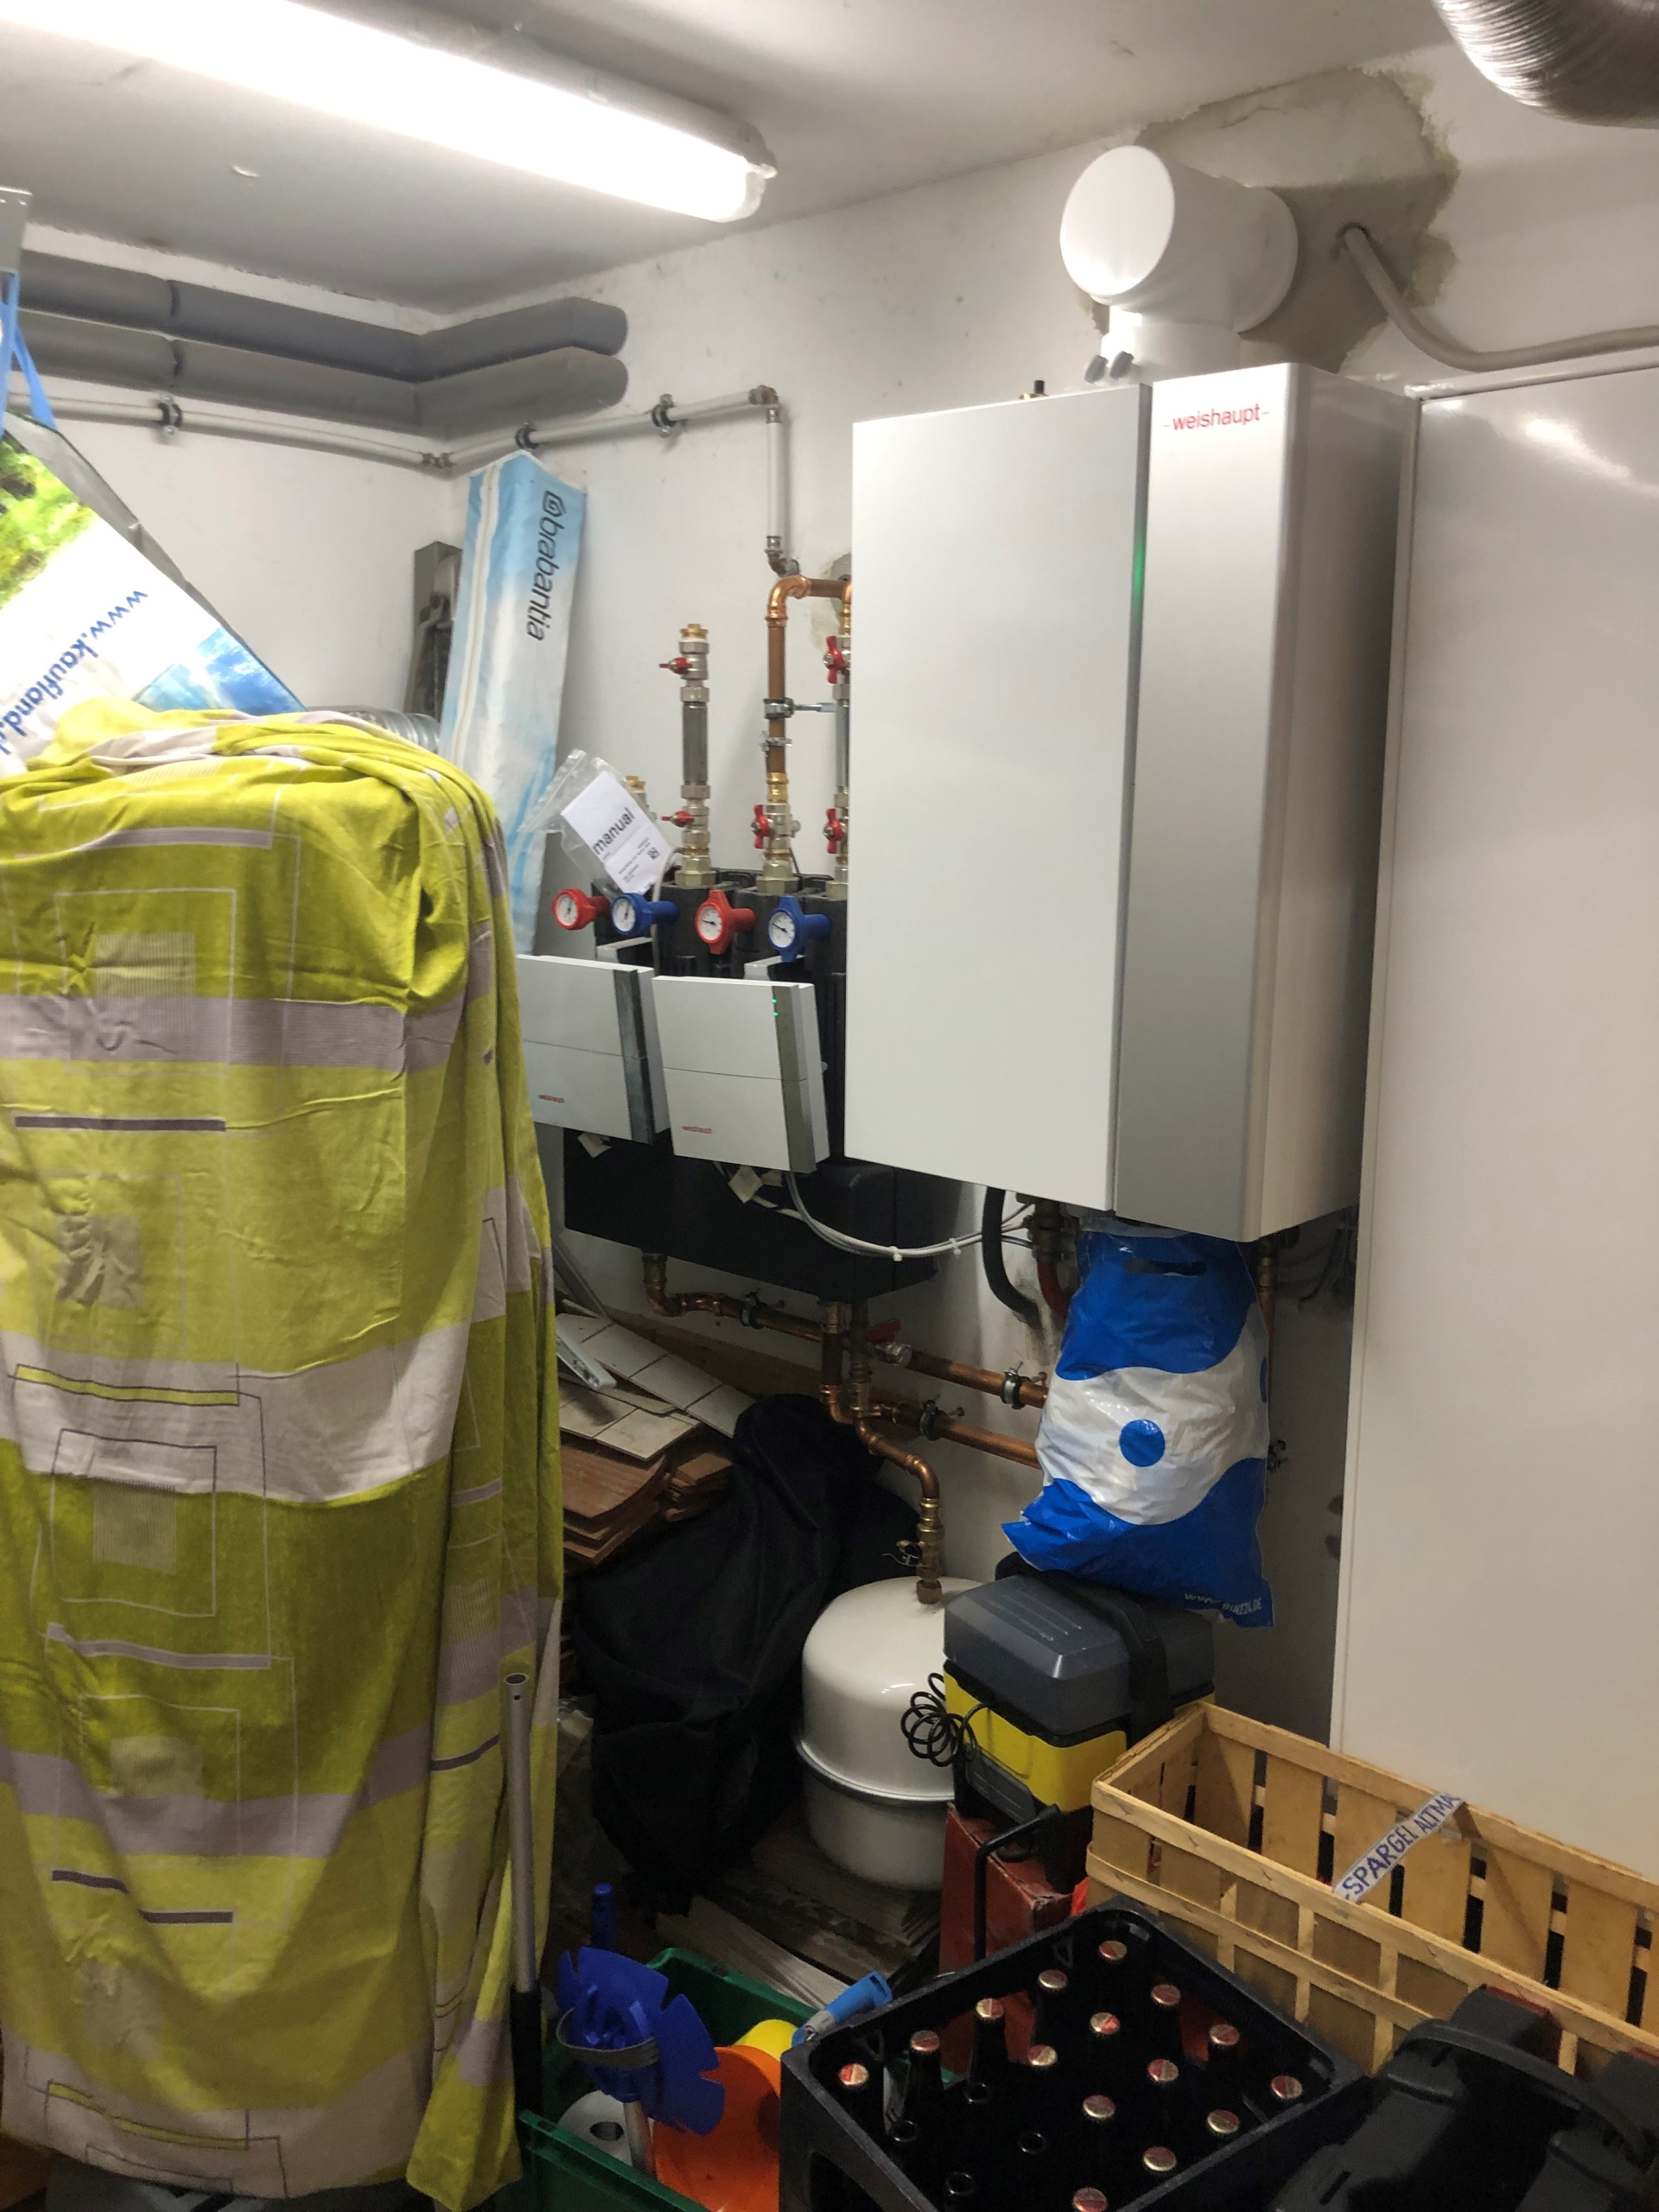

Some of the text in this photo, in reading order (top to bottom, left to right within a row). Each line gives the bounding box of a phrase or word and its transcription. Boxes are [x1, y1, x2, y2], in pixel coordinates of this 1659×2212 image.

[526, 516, 566, 641] brabantia
[592, 807, 636, 855] manual
[1342, 1825, 1419, 1895] SPARGEL
